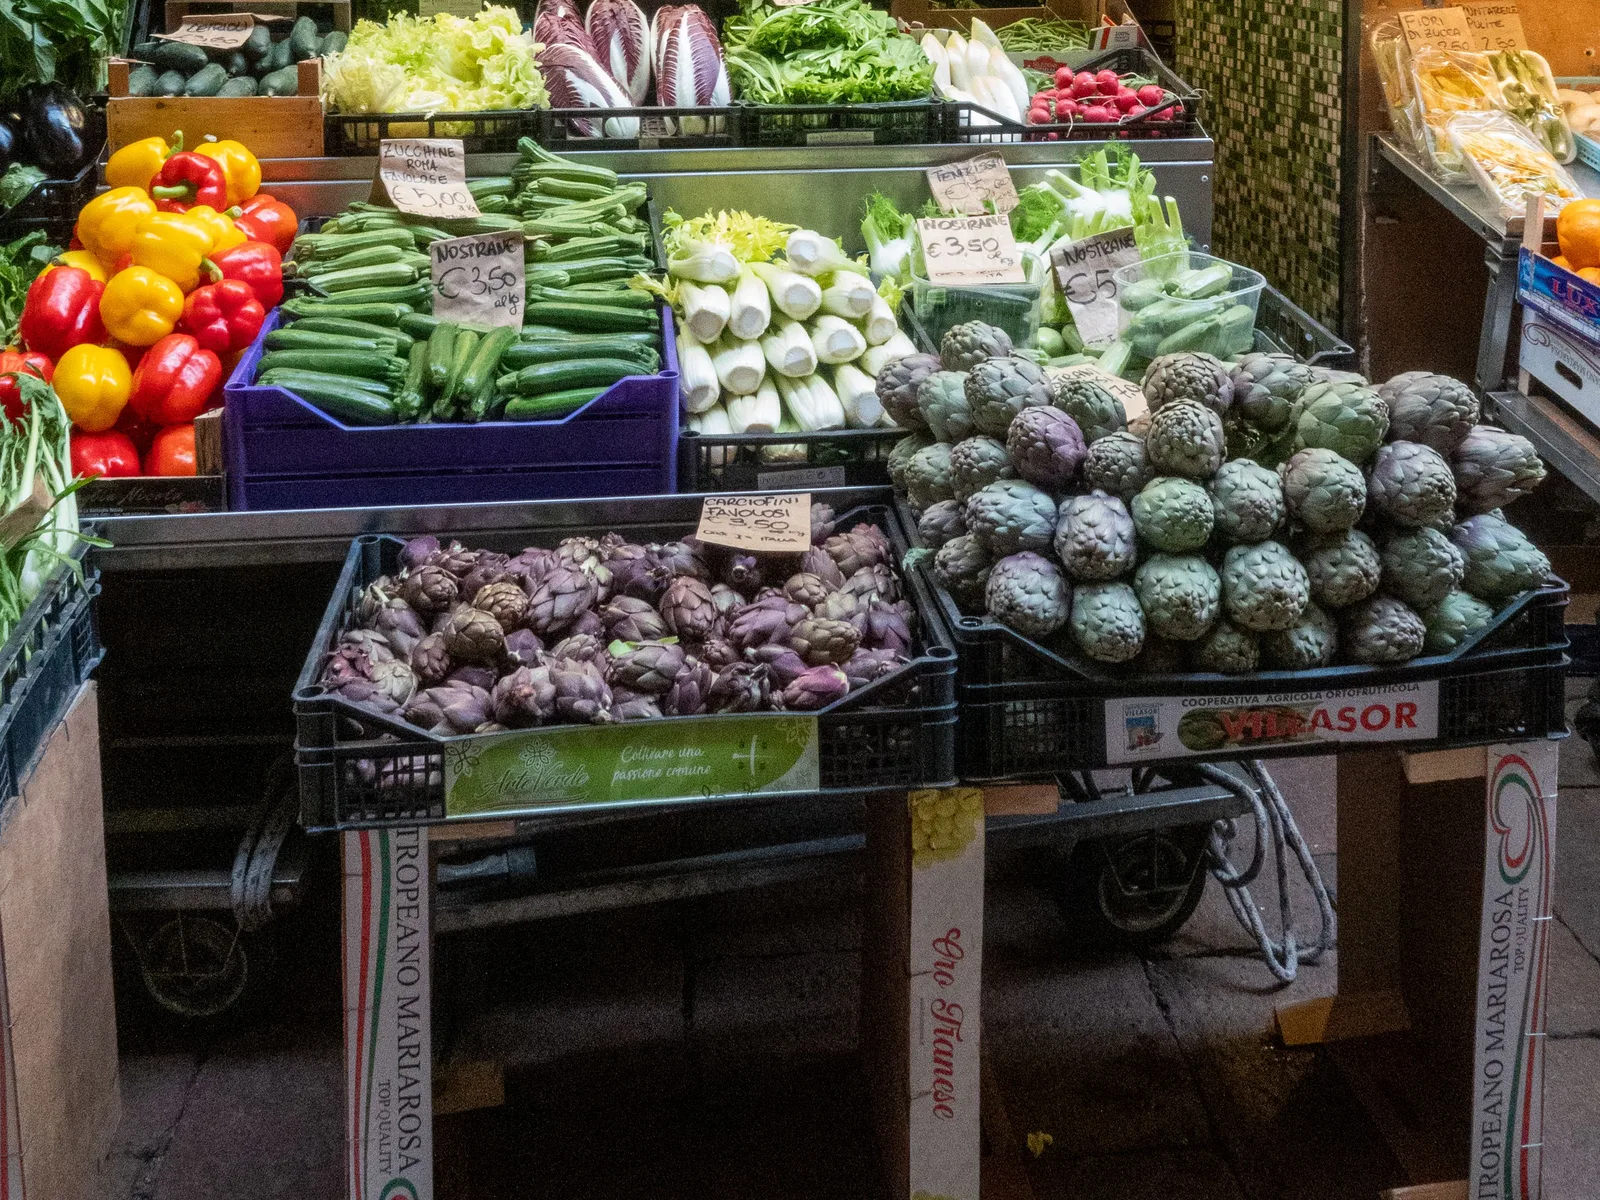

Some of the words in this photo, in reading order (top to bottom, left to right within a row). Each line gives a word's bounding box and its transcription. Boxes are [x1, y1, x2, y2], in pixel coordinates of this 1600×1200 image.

[1403, 14, 1444, 28] FIORI
[383, 142, 456, 159] ZUCCHINE
[406, 158, 438, 171] ROMA
[383, 171, 448, 184] FAVOLOSE
[923, 217, 1008, 231] NOSTRANE
[436, 238, 517, 263] NOSTRANE
[704, 497, 799, 506] CARCIOFINI
[704, 507, 790, 518] FAVOLOSI
[1181, 695, 1259, 708] COOPERATIVA
[1266, 691, 1322, 704] AGRICOLA
[1325, 683, 1420, 700] ORTOFRUTTICOLA
[678, 747, 705, 758] una
[610, 768, 662, 787] passione
[666, 764, 713, 778] comune
[396, 826, 420, 987] TROPEANO
[932, 928, 964, 989] Oro
[1484, 888, 1514, 1053] MARIAROSA
[397, 996, 421, 1174] MARIAROSA
[1478, 1059, 1504, 1200] TROPEANO
